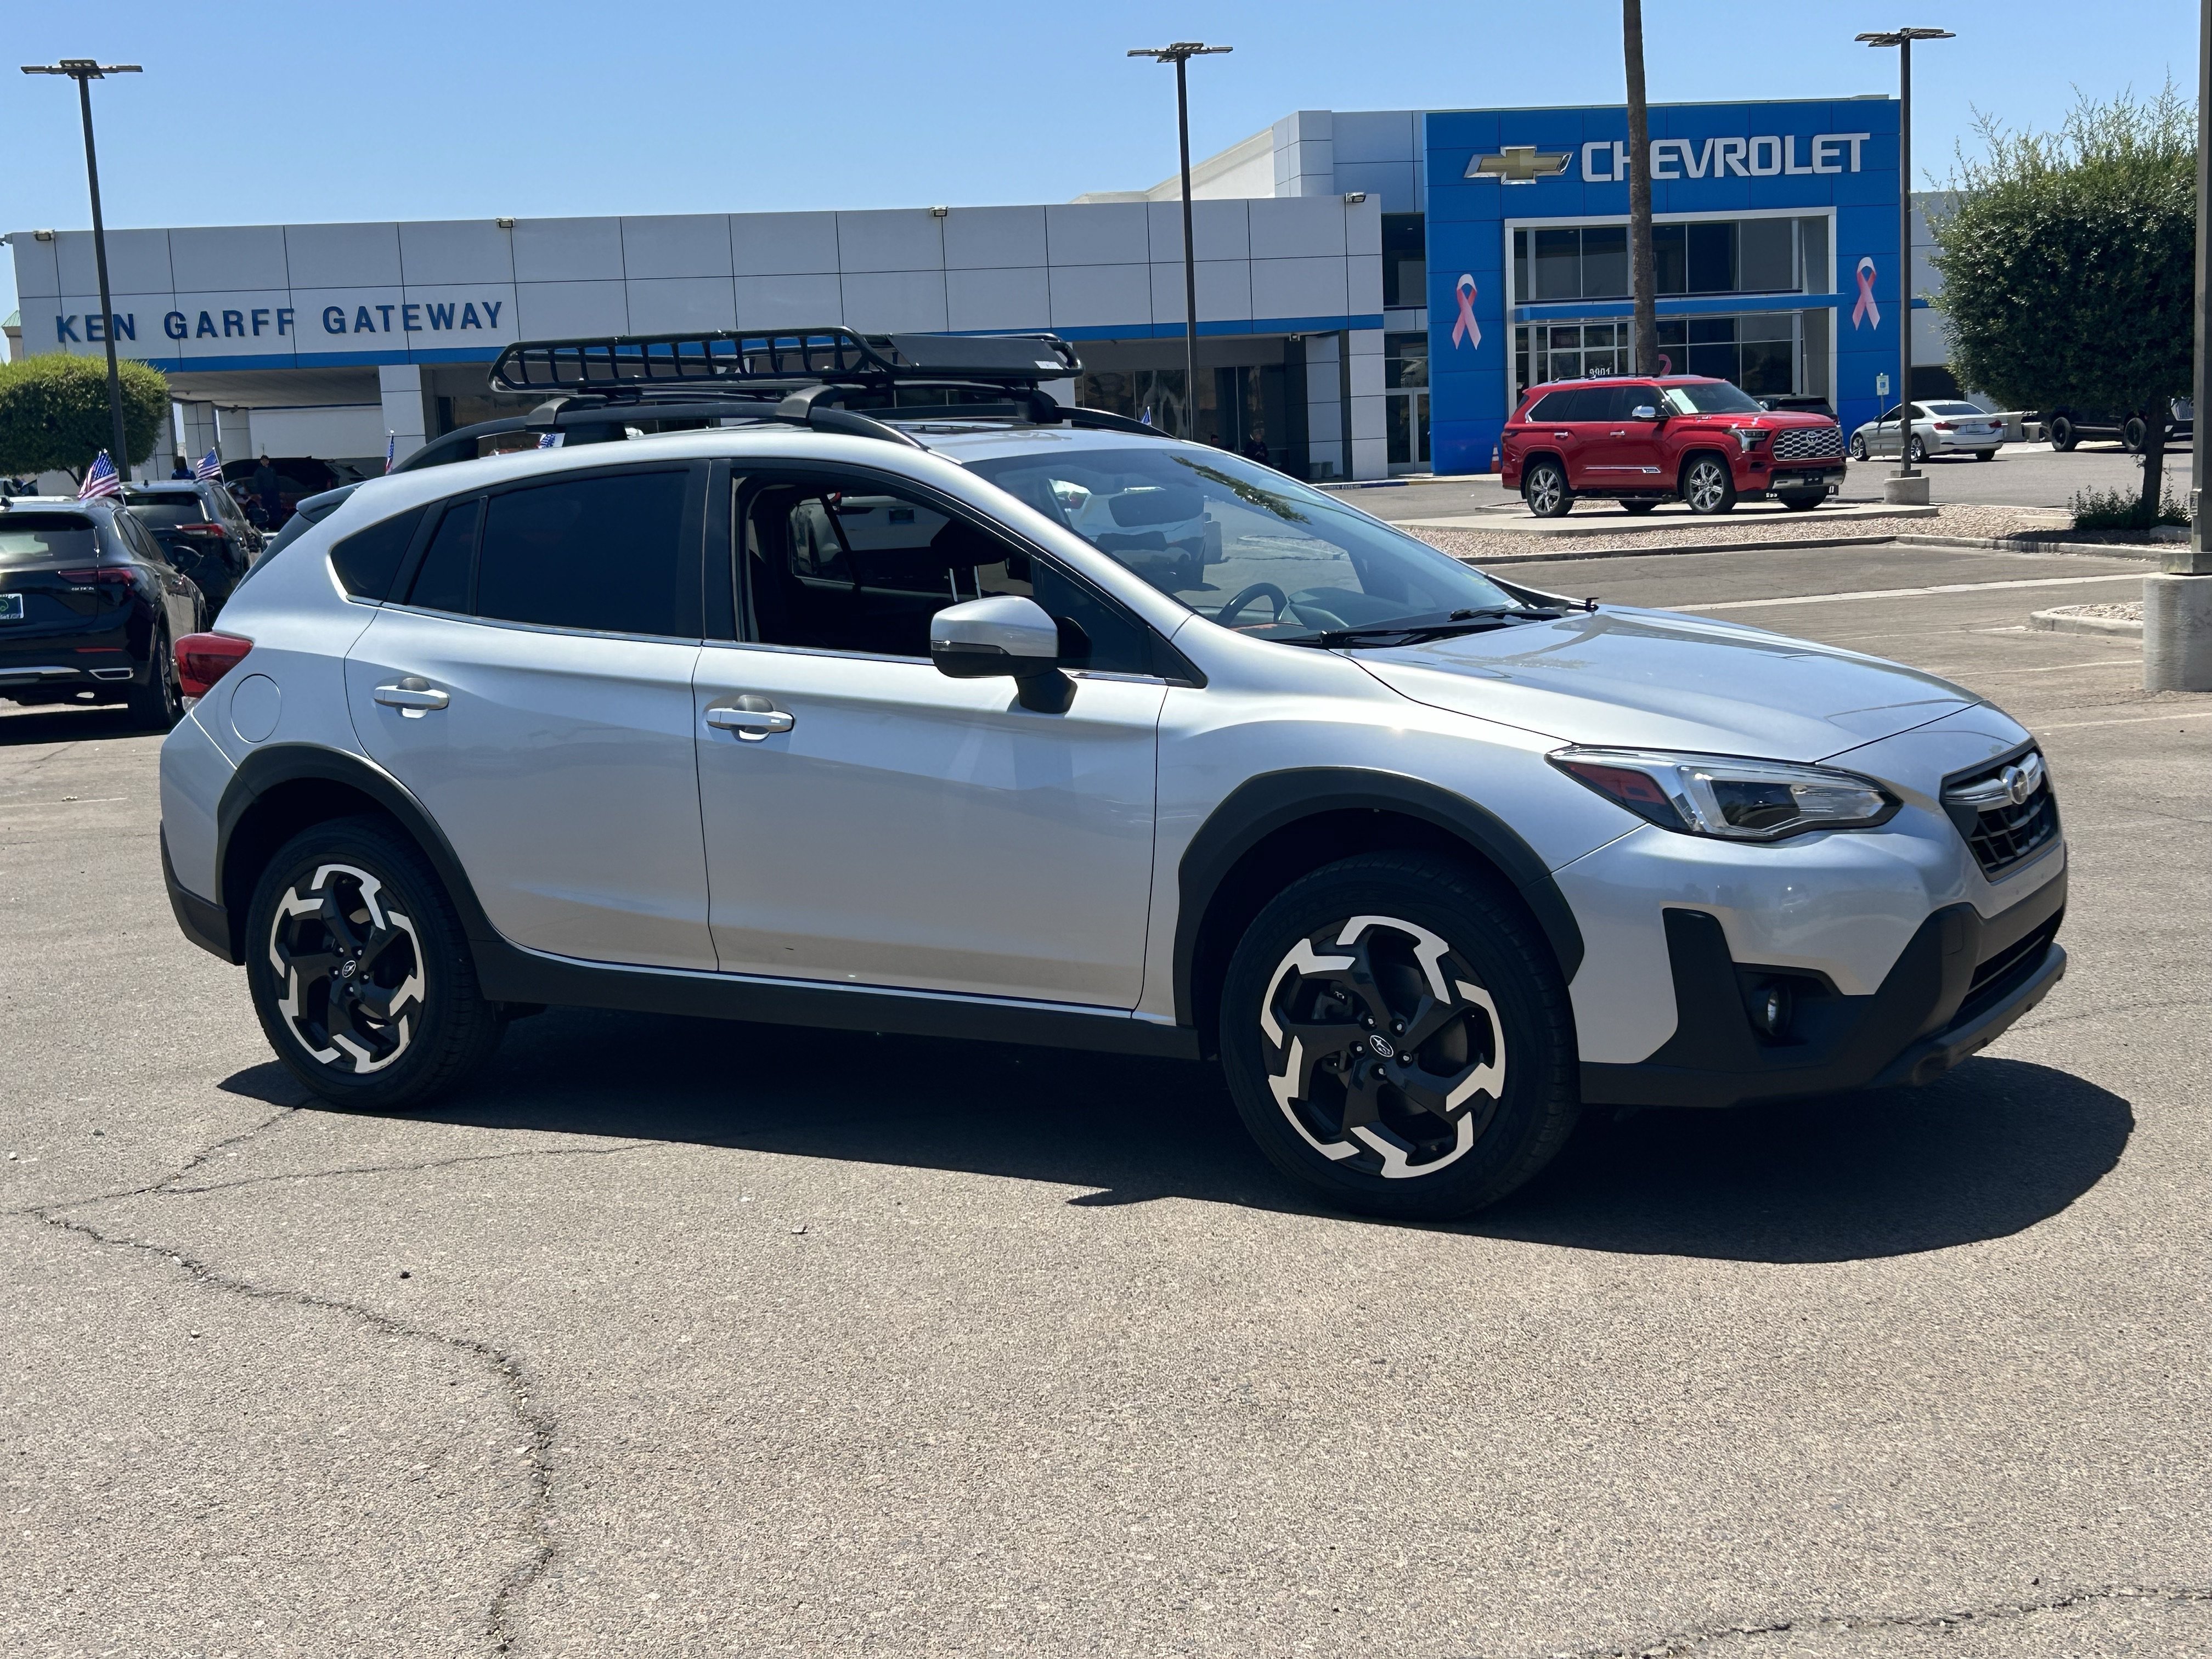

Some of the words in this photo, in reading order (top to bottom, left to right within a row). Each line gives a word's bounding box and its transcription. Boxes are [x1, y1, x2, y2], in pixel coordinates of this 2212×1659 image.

[55, 313, 136, 343] KEN
[164, 308, 295, 340] GARFF
[323, 301, 503, 334] GATEWAY
